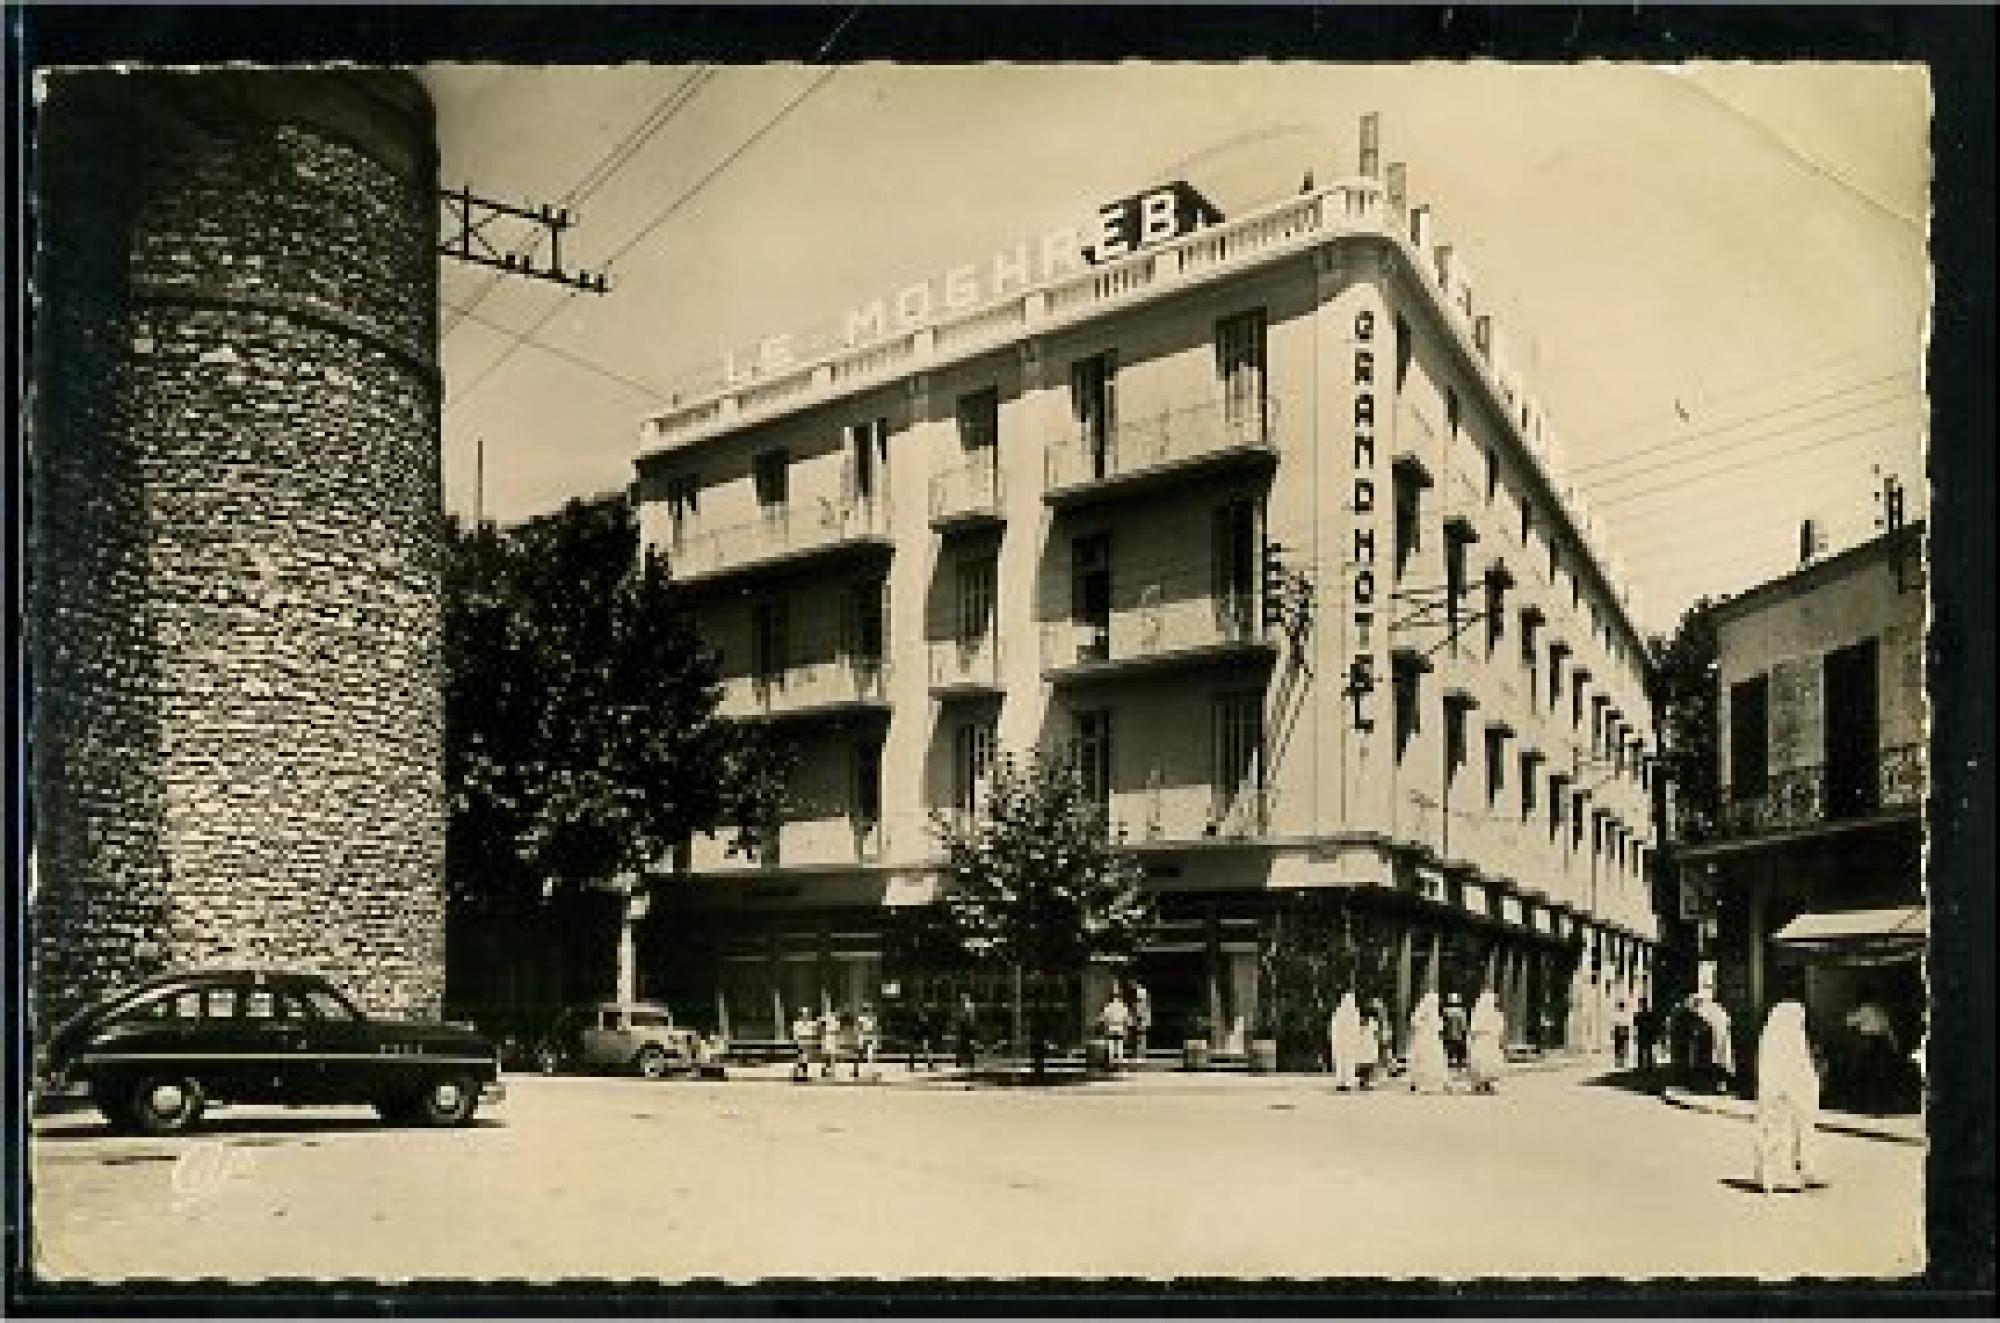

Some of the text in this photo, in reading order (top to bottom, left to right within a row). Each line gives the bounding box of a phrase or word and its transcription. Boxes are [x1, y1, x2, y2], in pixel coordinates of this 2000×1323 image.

[722, 191, 1178, 383] LE MOGHREB
[1354, 310, 1375, 733] GRAND HOTEL
